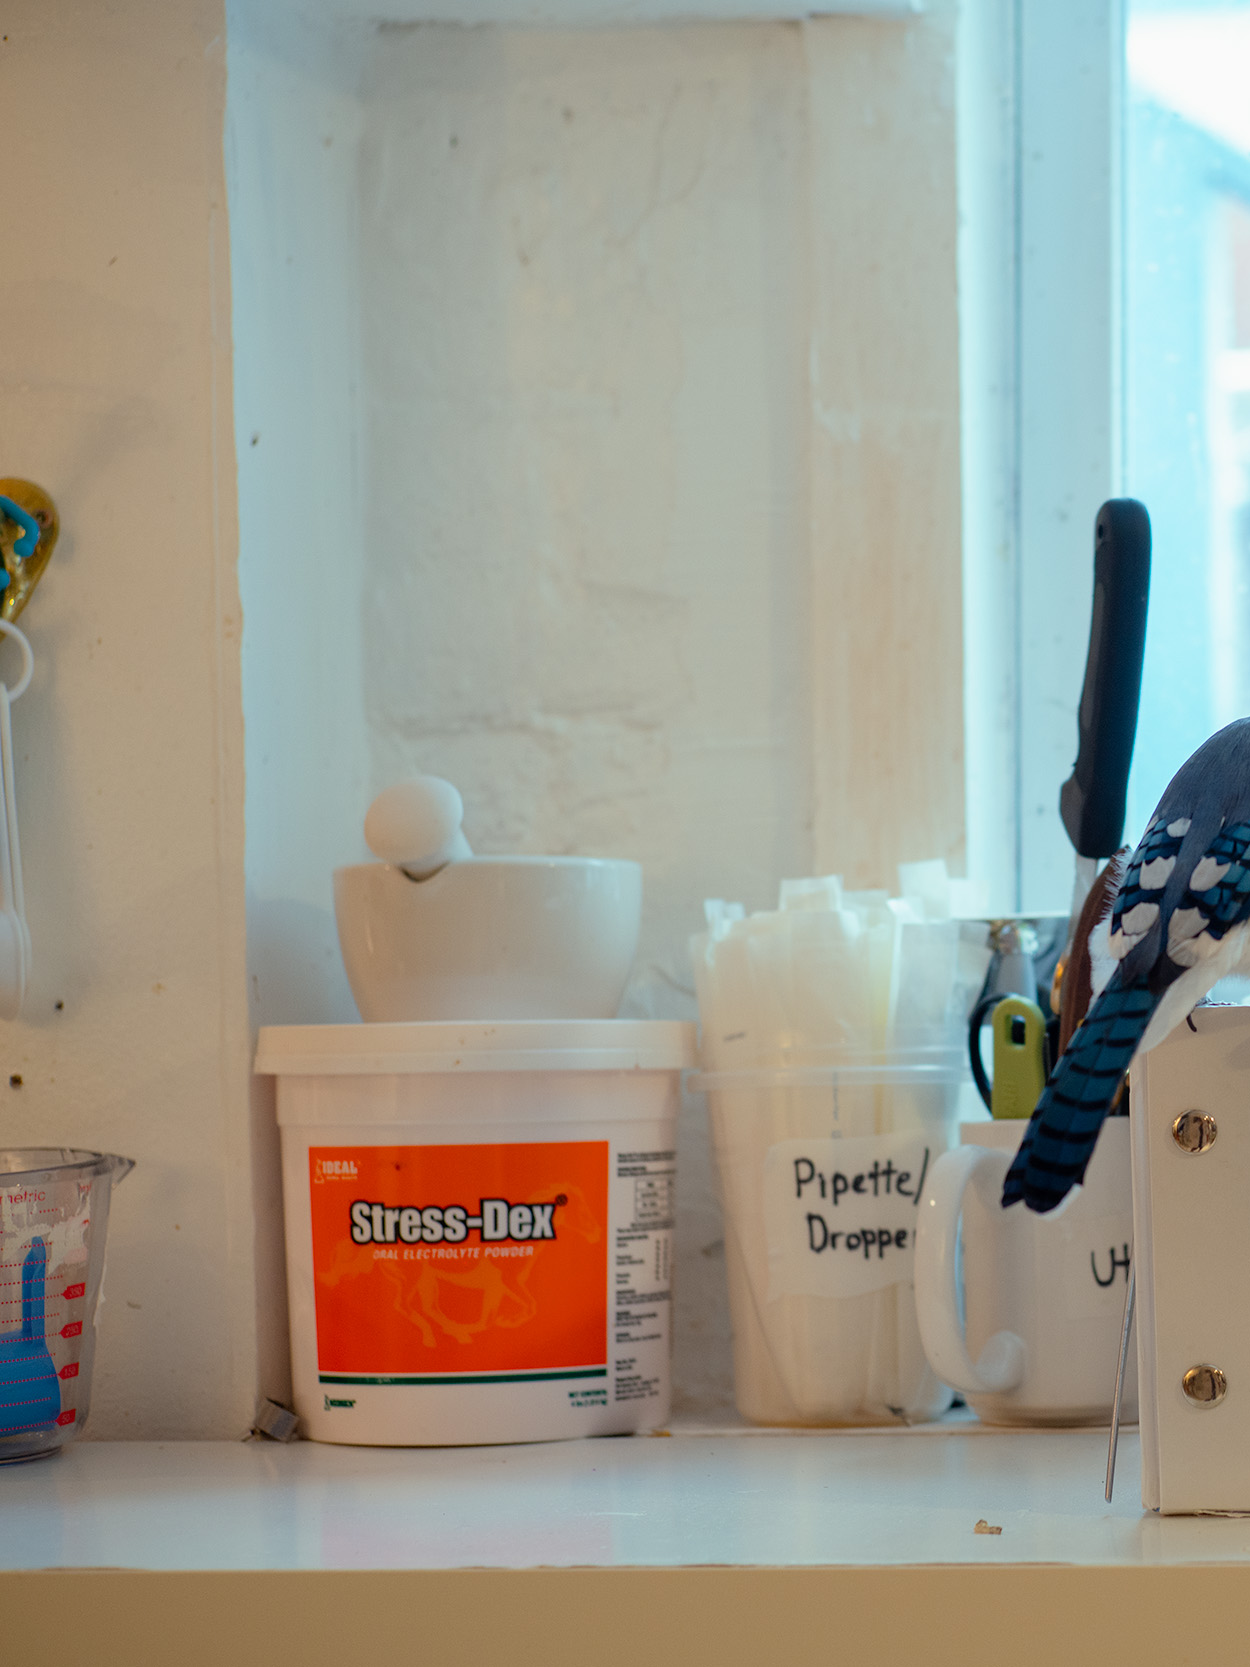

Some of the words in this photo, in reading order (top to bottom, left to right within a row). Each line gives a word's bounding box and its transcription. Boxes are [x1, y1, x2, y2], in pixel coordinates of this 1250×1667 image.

[322, 1160, 358, 1175] IDEAL
[794, 1147, 930, 1206] Pipette/
[806, 1211, 917, 1260] Droppe
[373, 1249, 399, 1260] ORAL
[402, 1247, 481, 1260] ELECTROLYTE
[484, 1246, 534, 1258] POWDER
